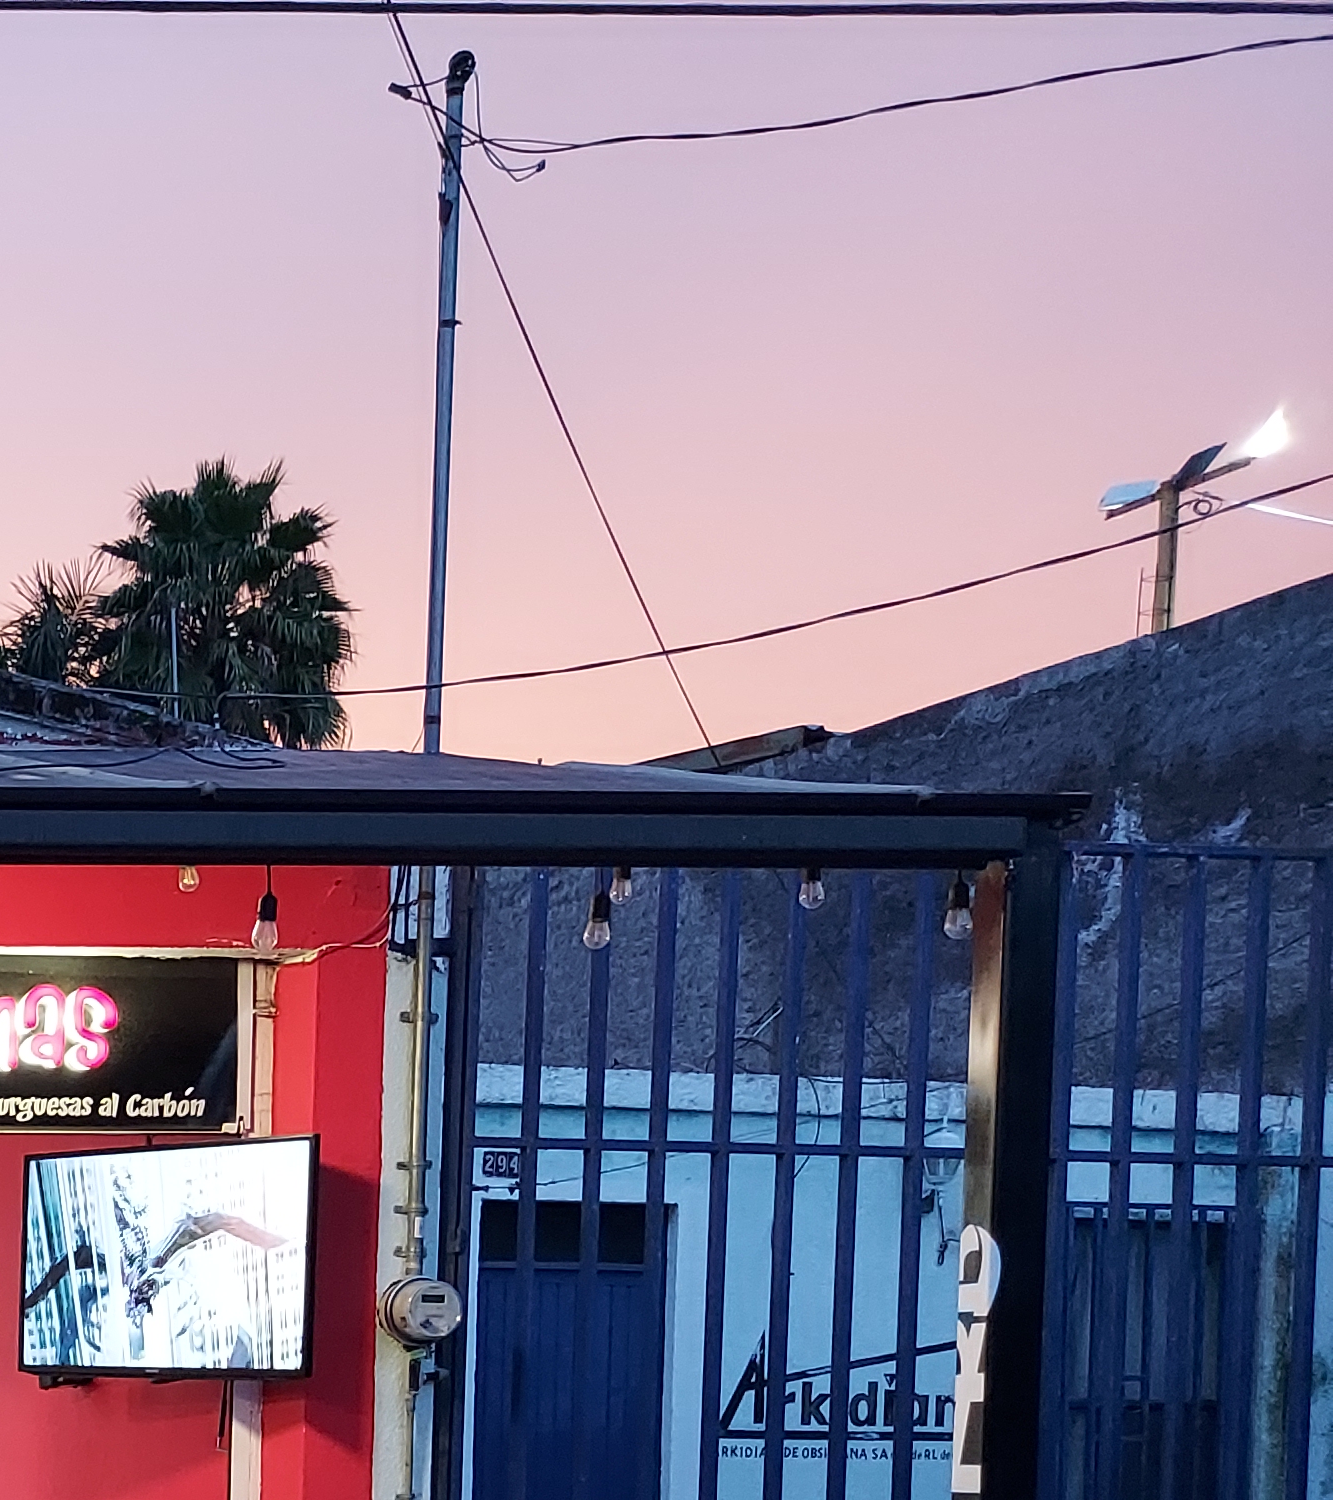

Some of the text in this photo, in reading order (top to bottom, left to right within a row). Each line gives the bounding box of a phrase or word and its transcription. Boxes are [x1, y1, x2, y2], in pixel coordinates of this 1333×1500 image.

[98, 1092, 120, 1119] al
[125, 1086, 206, 1118] Carbón
[484, 1154, 519, 1174] 294
